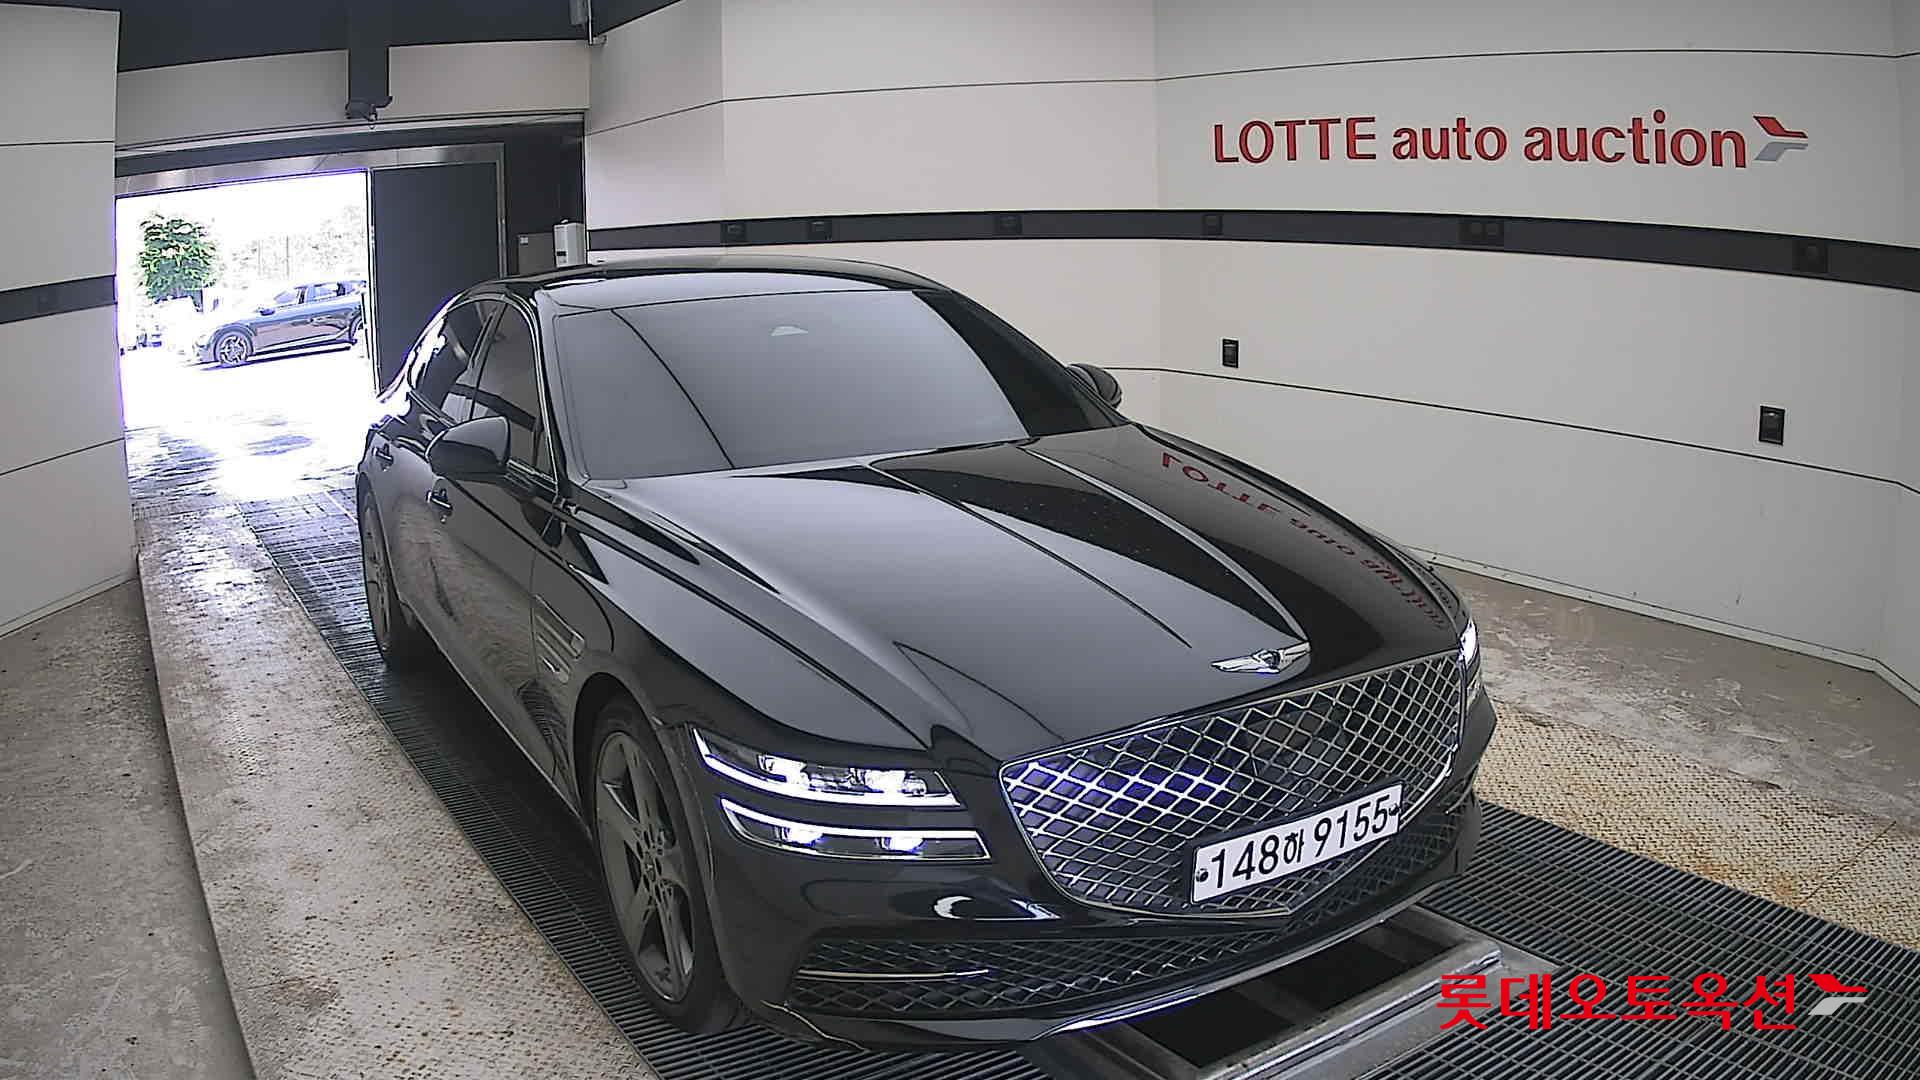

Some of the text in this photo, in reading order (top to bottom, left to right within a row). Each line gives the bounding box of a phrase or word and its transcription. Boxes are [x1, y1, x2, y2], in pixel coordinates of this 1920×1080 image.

[1213, 109, 1748, 169] LOTTE auto auction
[1211, 794, 1391, 889] 148하 9155
